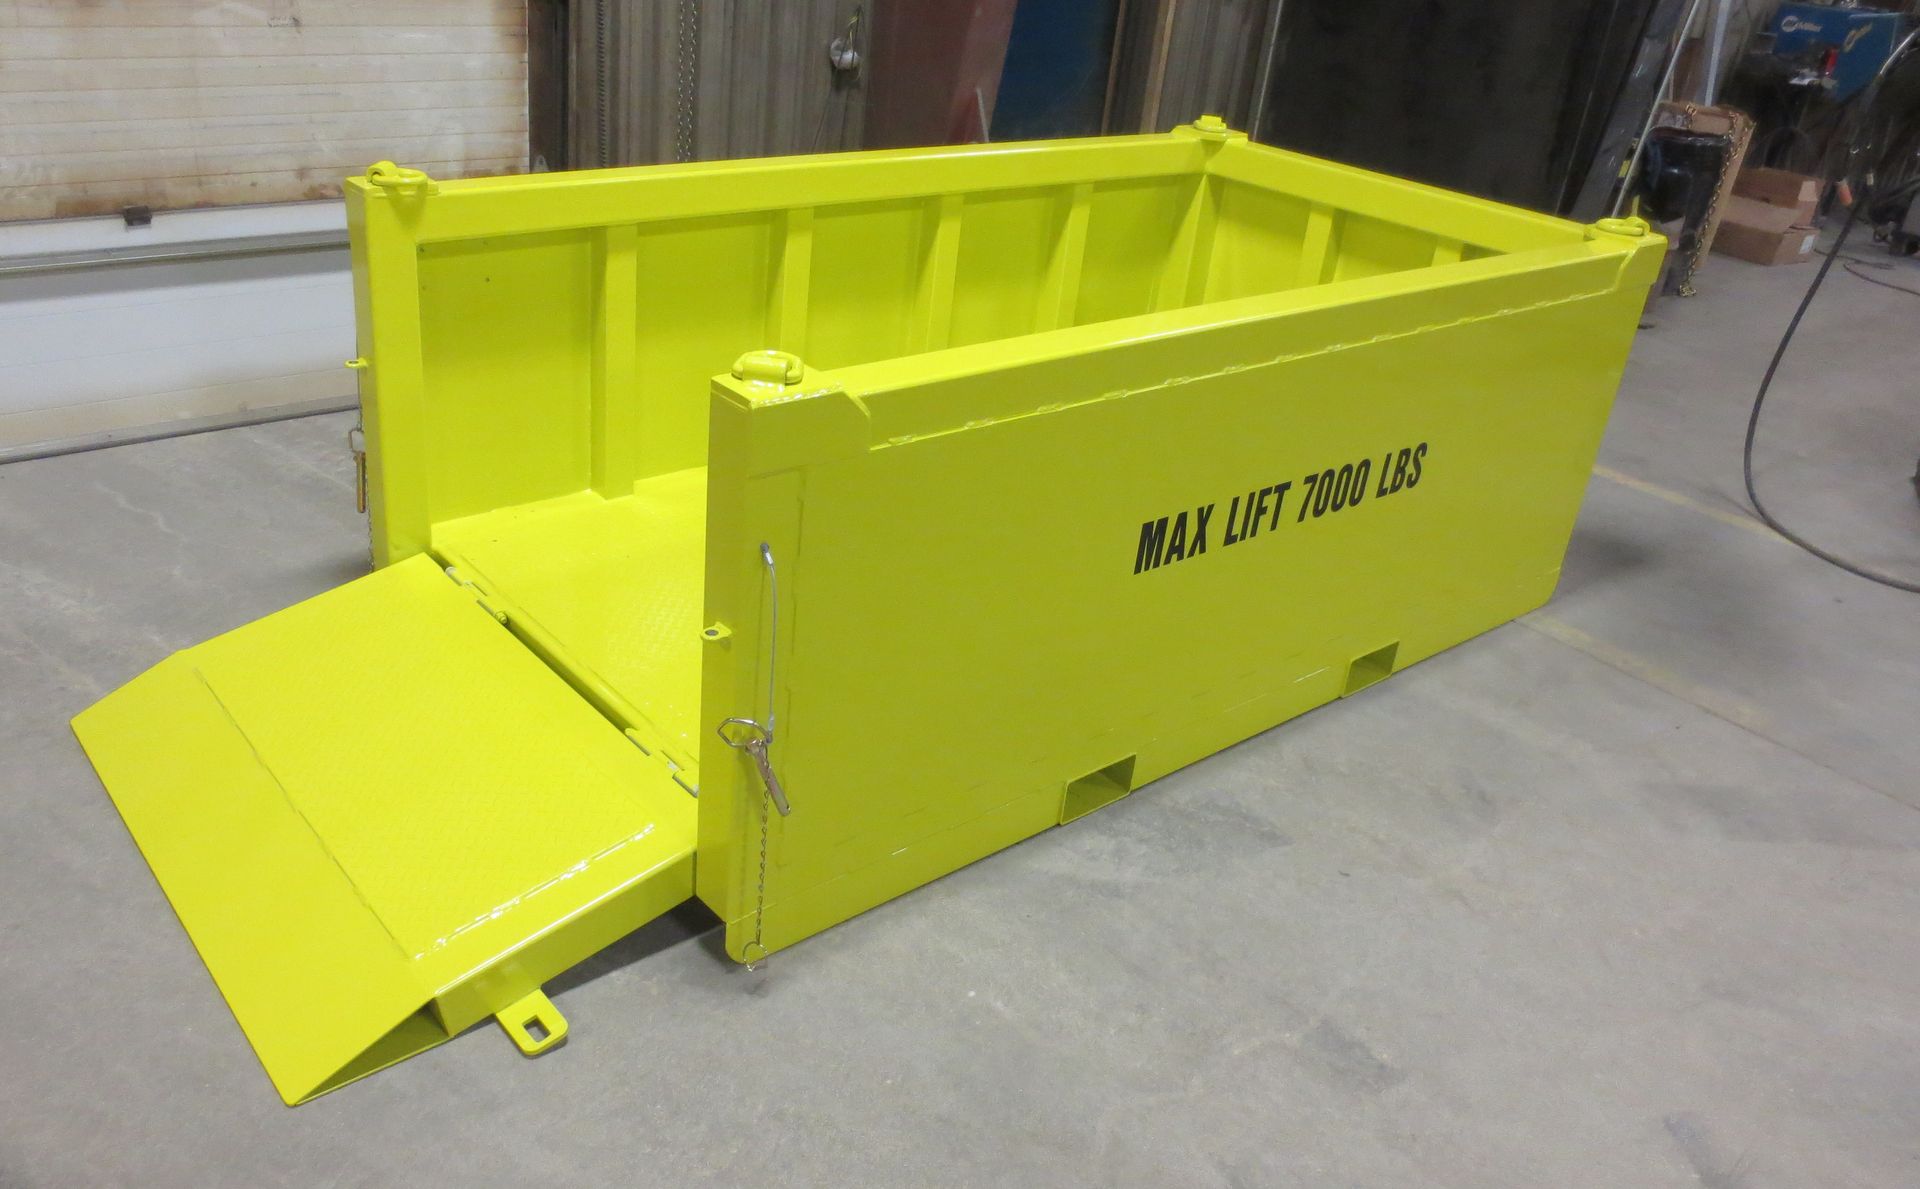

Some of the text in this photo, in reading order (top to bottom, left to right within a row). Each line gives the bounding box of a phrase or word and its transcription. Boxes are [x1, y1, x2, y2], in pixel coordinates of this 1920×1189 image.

[1133, 442, 1428, 576] MAX LIFT 7000 LBS
